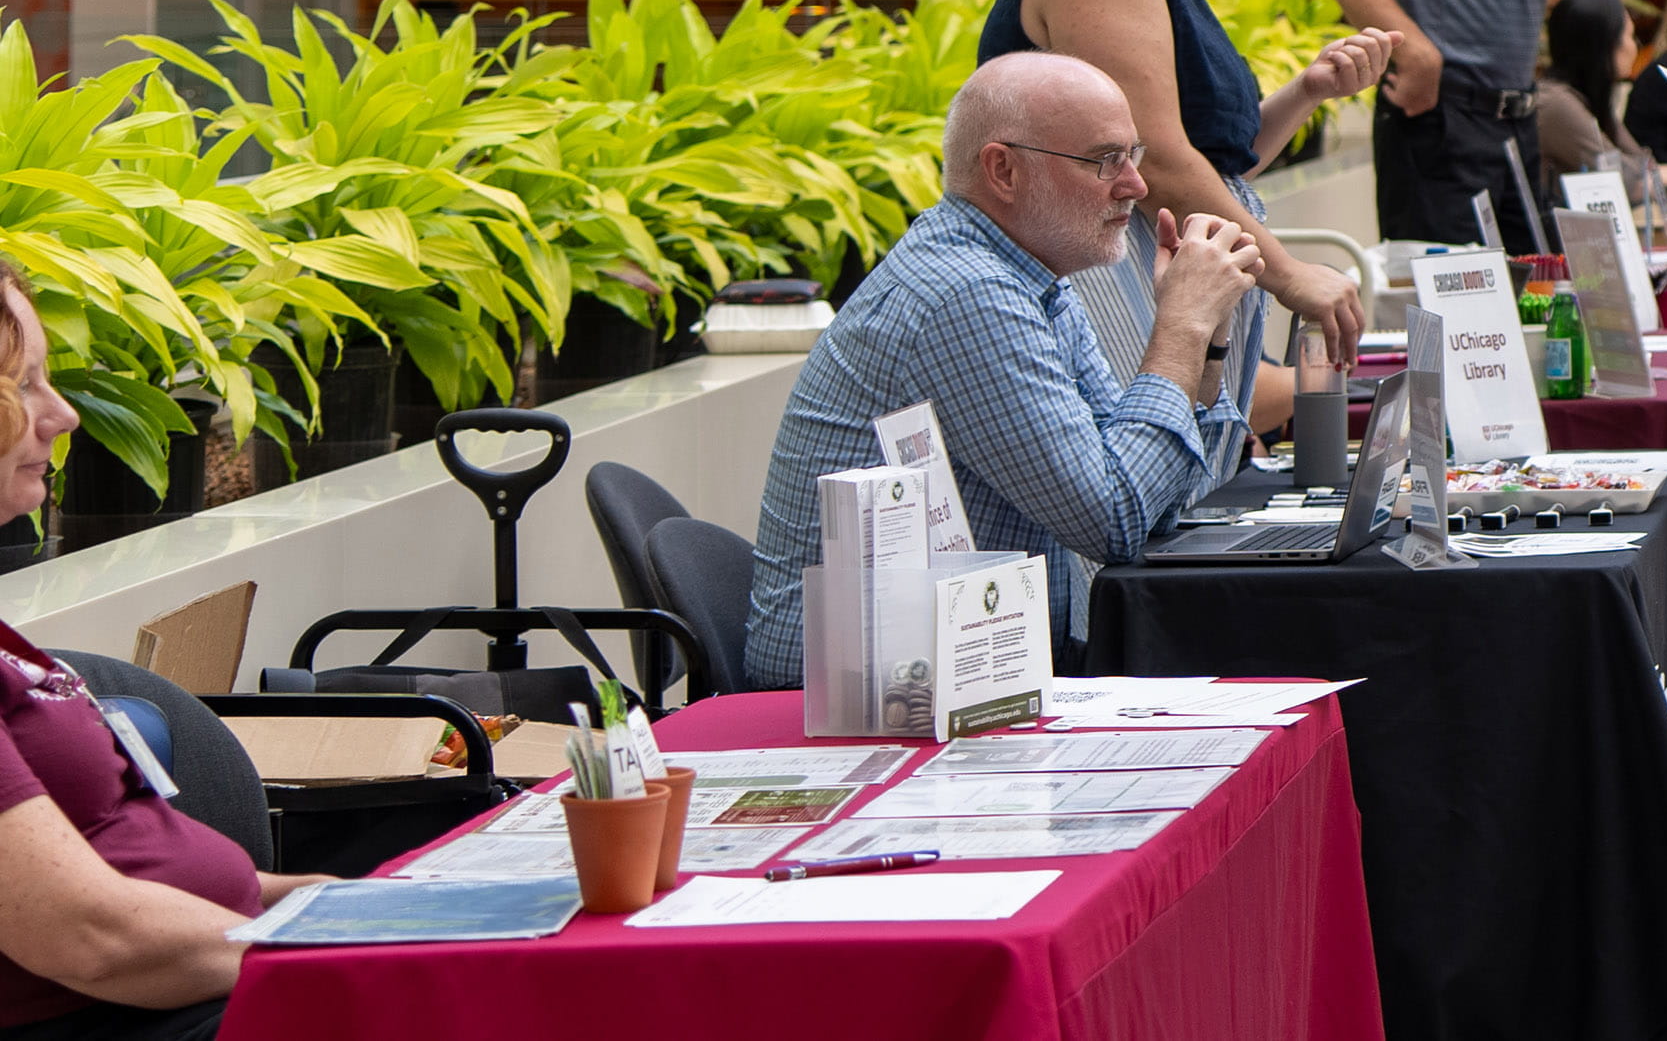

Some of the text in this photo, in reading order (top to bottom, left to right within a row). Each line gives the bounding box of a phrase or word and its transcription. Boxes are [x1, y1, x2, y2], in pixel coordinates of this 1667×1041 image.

[1433, 269, 1486, 293] CHICAGO BOOTH
[1449, 331, 1507, 352] UChicago
[1463, 362, 1506, 381] Library
